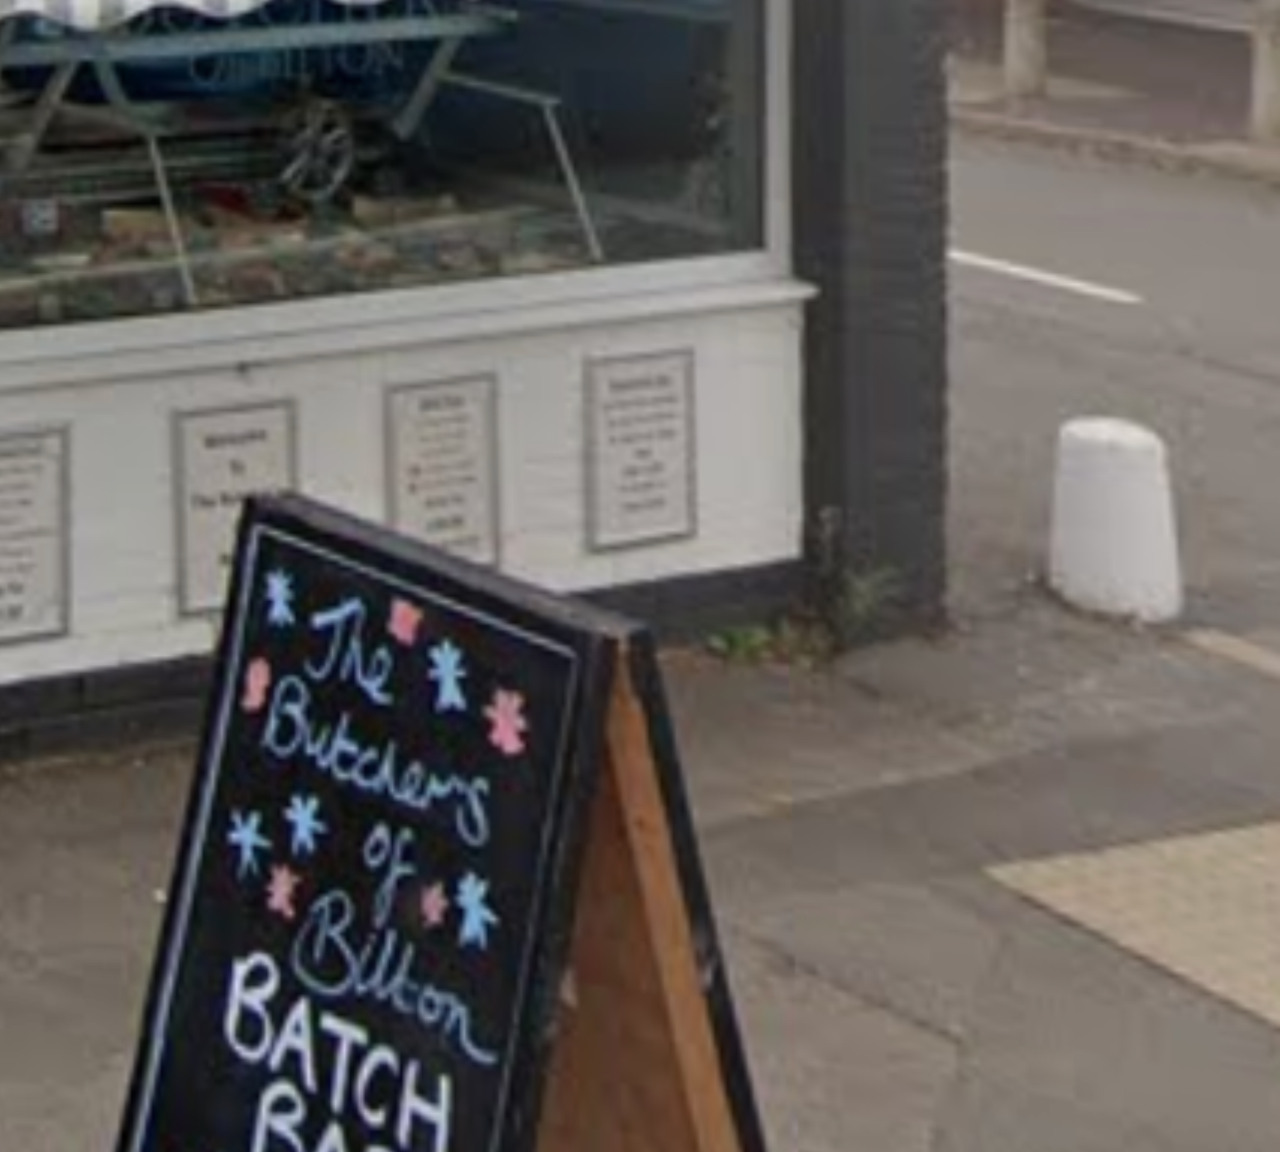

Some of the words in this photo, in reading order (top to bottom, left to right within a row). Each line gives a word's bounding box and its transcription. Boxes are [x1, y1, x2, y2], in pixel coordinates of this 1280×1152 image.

[304, 597, 393, 706] The
[363, 822, 417, 929] of
[292, 888, 499, 1064] Bilton
[225, 951, 451, 1152] BATCH
